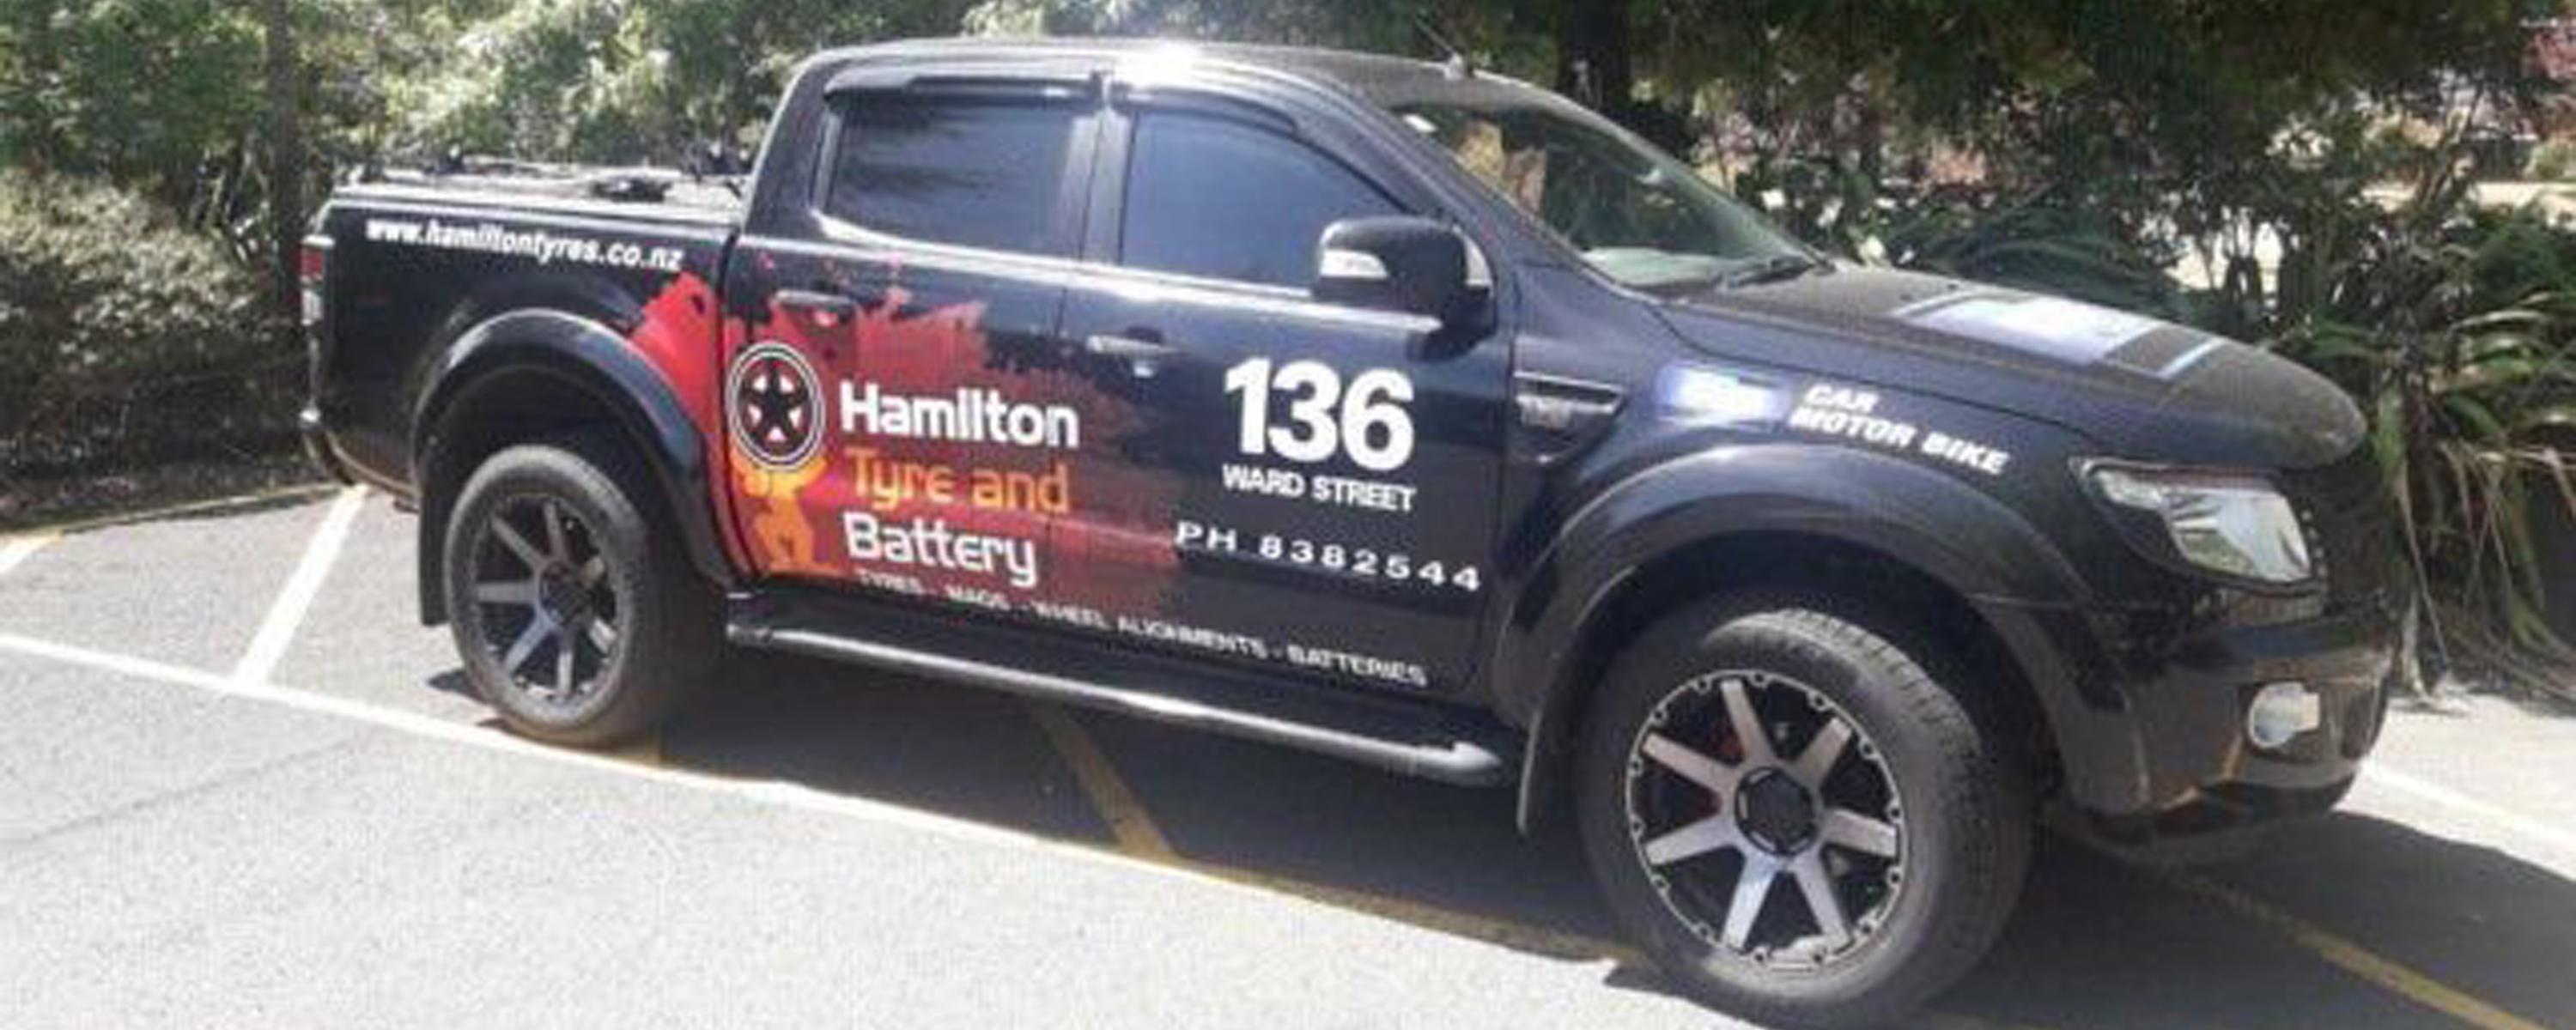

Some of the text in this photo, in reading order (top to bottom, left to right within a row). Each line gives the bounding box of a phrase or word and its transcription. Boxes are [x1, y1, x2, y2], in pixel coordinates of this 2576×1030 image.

[365, 217, 683, 271] www.hamiltontyres.co.nz
[840, 380, 1079, 448] Hamilton
[1224, 357, 1415, 471] 136
[1806, 385, 1880, 413] CAR
[1788, 408, 2010, 475] MOTOR BIKE
[846, 447, 1068, 513] Tyre and
[1223, 464, 1417, 512] WARD STREET
[842, 512, 1037, 587] Battery
[1176, 520, 1481, 592] PH 8382544
[1286, 644, 1429, 687] BATTERIES
